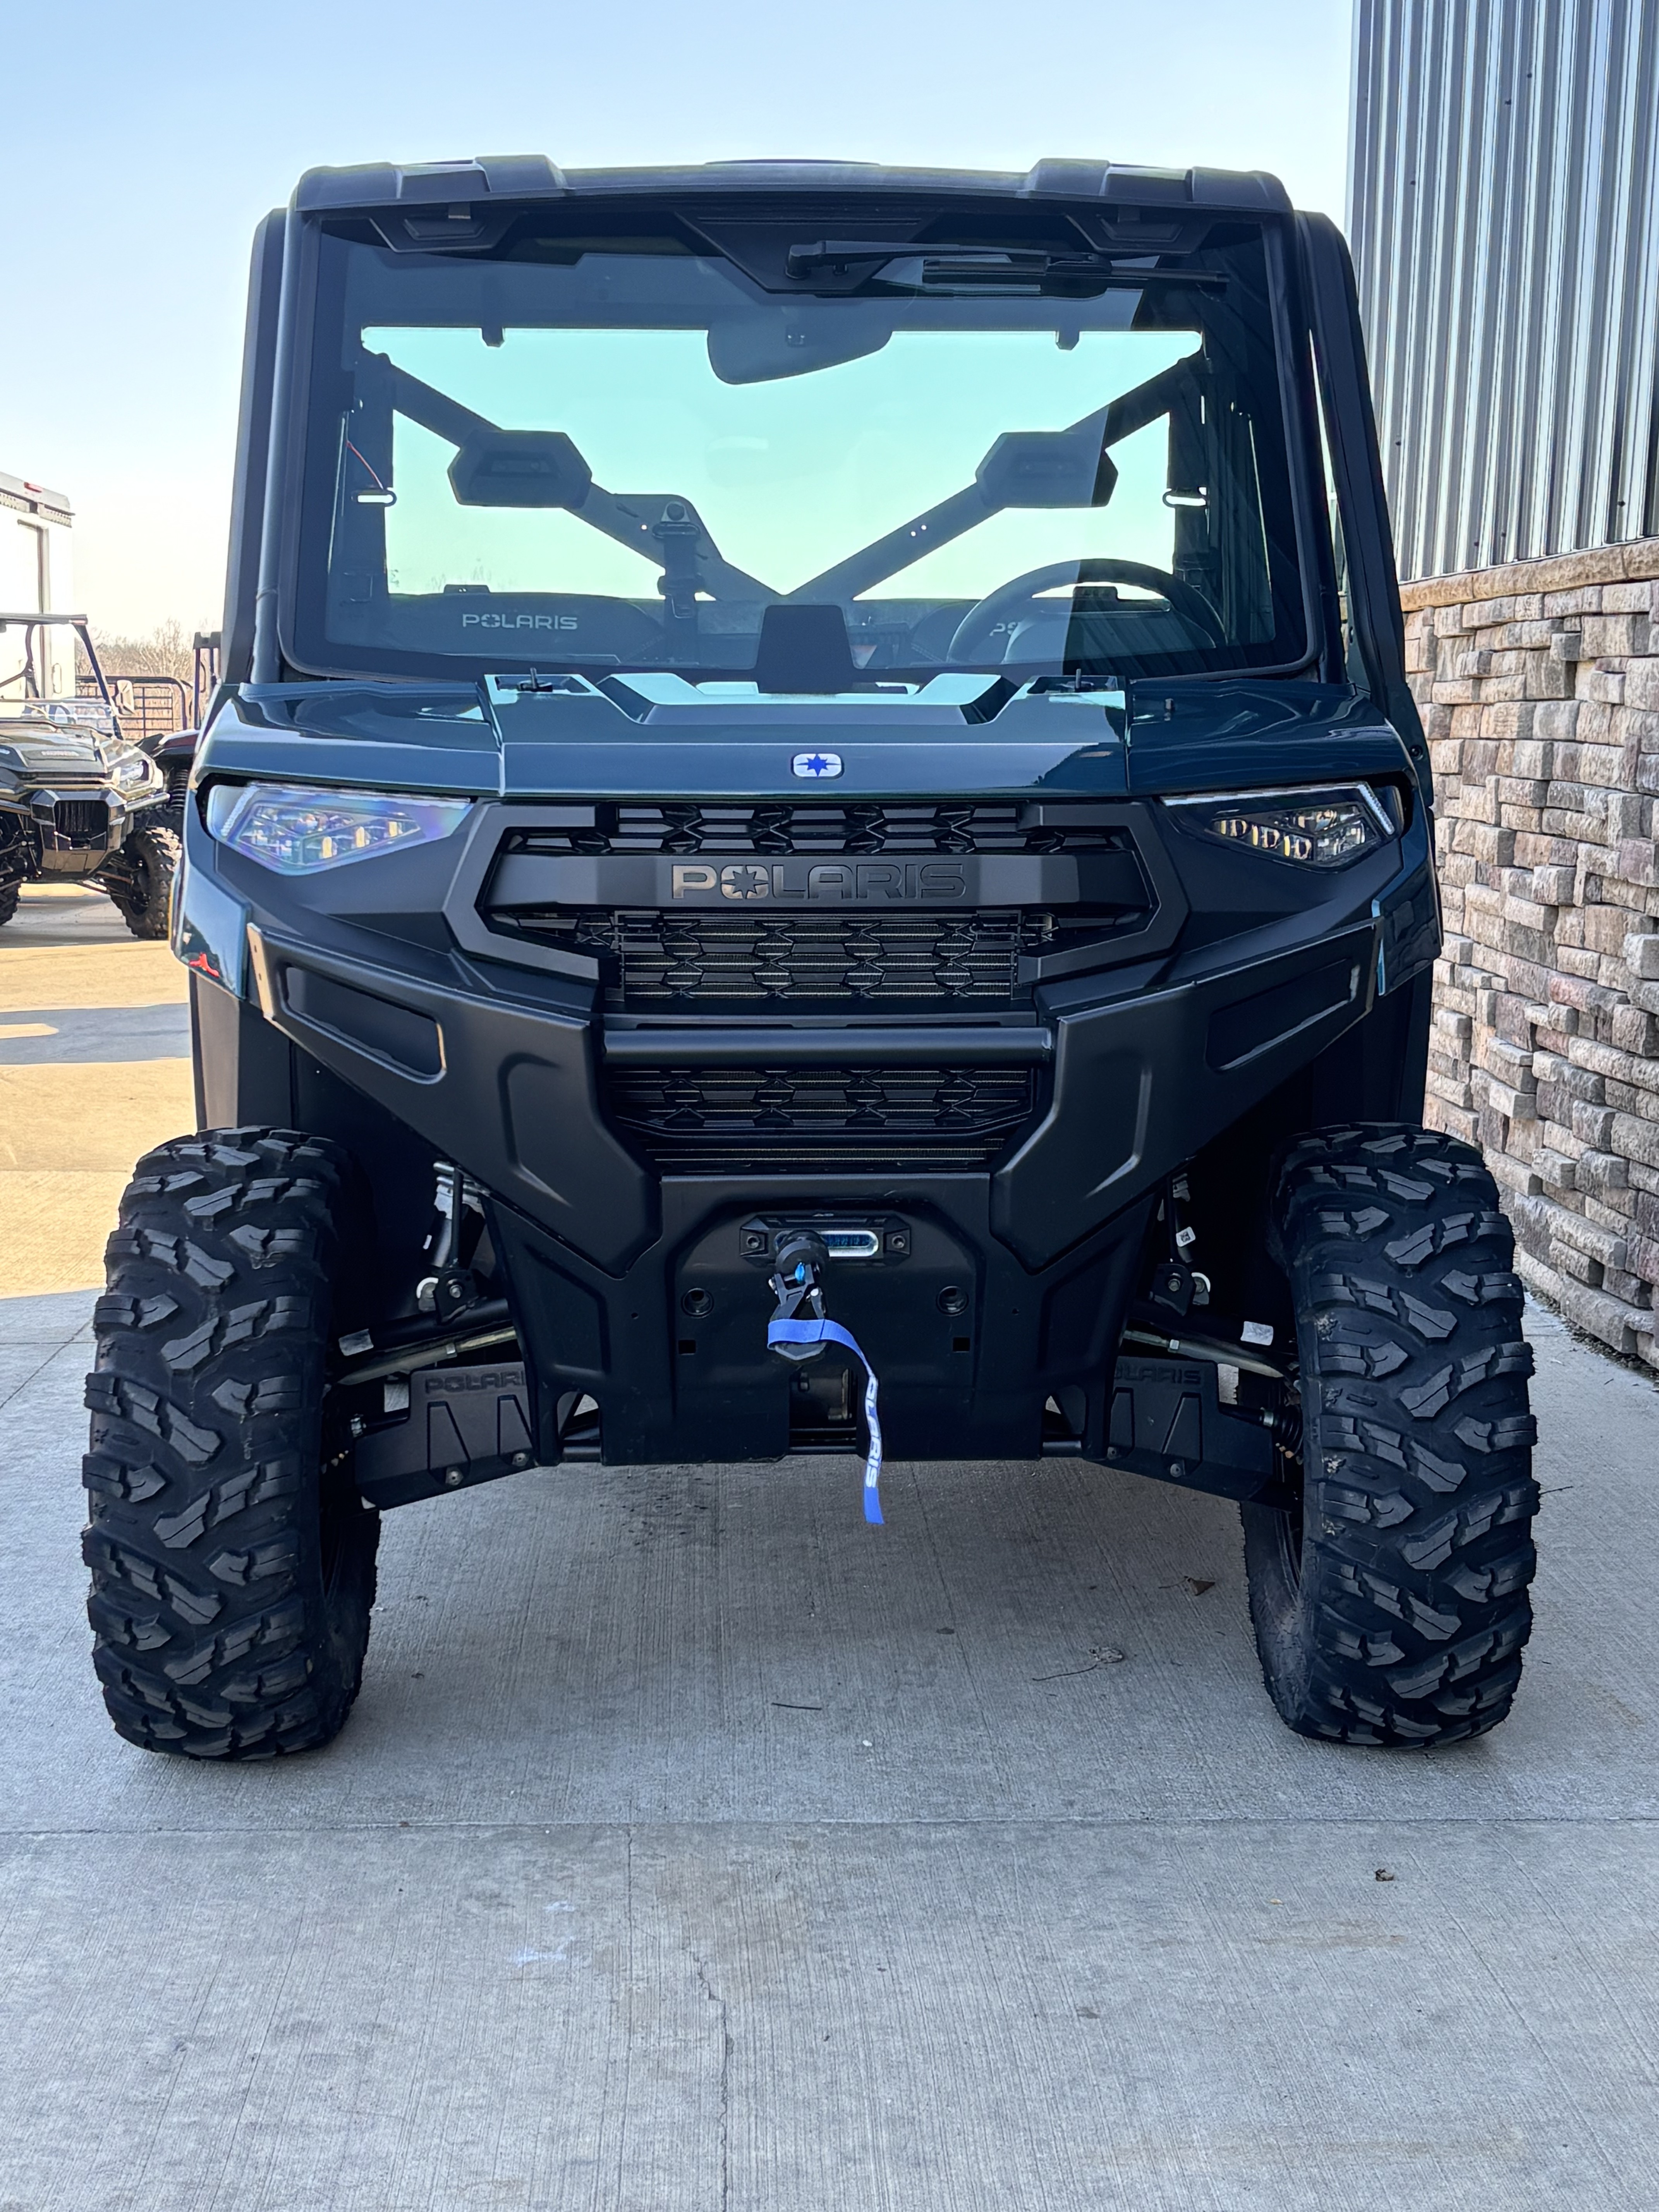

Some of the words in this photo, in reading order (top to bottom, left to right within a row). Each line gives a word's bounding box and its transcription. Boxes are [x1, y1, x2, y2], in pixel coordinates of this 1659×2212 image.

[462, 614, 578, 630] POLARIS
[671, 863, 966, 900] POLARIS
[425, 1370, 525, 1394] POLARI
[864, 1375, 881, 1488] OLARIS
